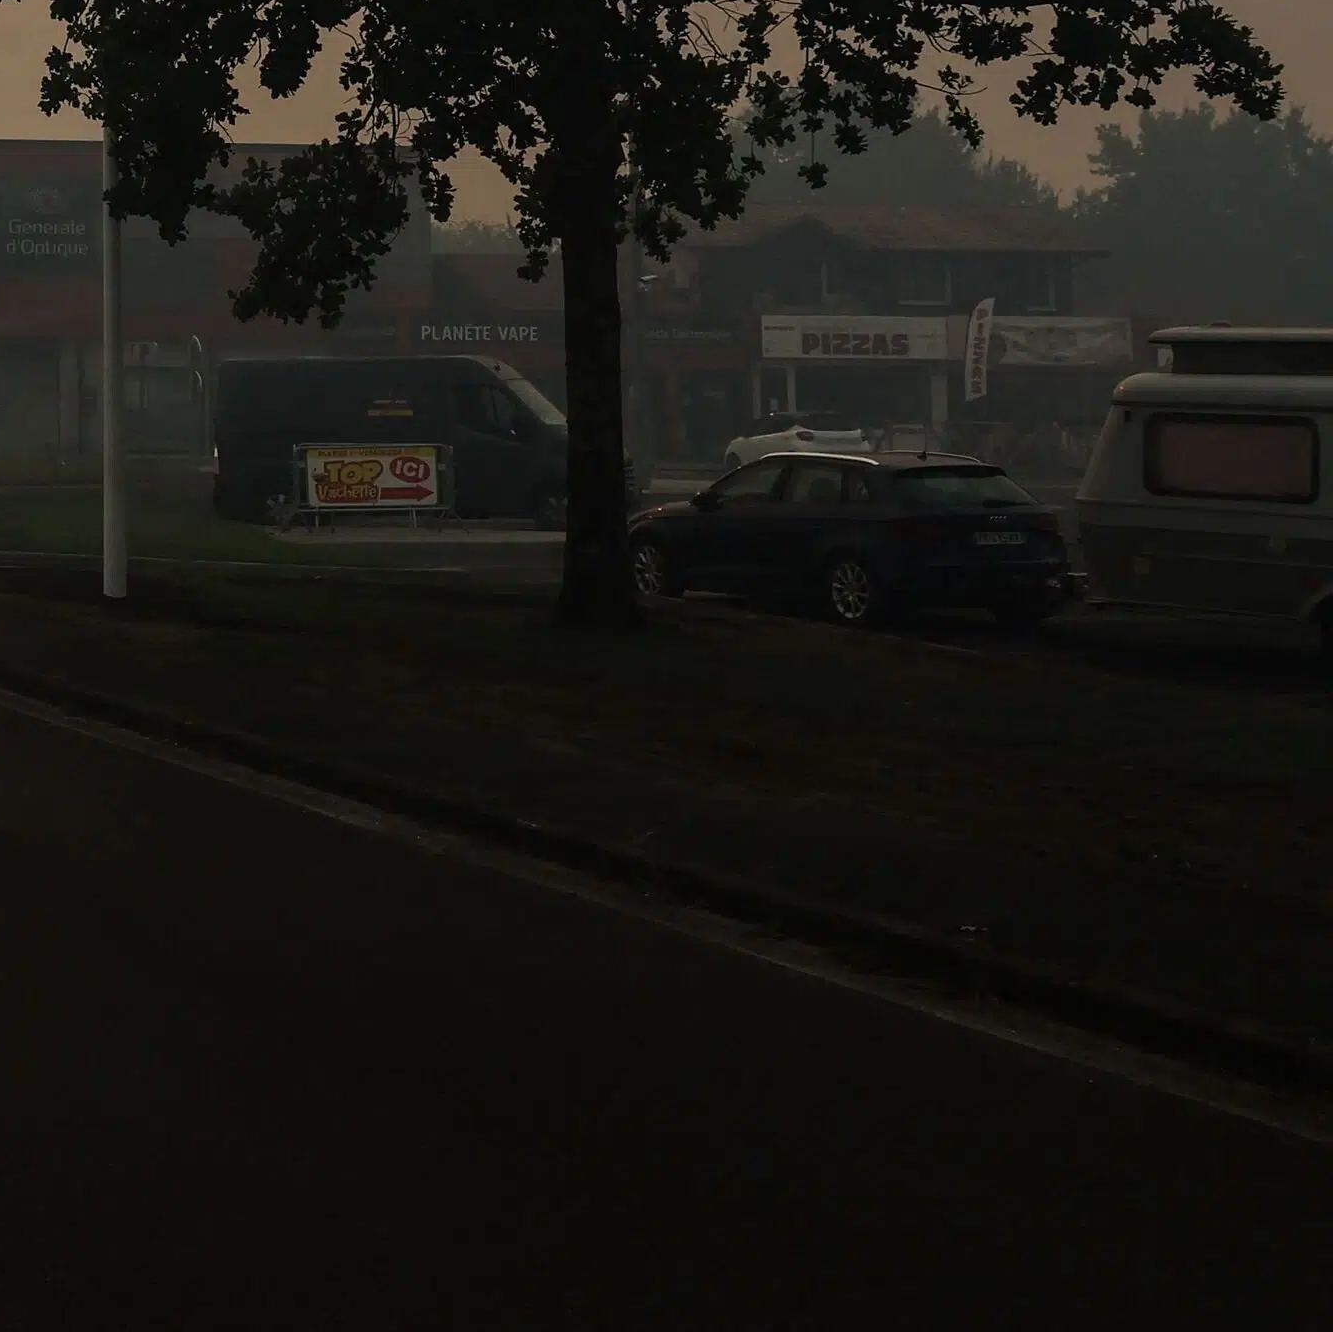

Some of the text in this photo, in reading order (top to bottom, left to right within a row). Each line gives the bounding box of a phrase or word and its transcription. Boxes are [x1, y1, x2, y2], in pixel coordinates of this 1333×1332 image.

[6, 238, 89, 261] d'Optique
[497, 325, 539, 341] VAPE
[801, 332, 910, 355] PIZZAS
[323, 459, 383, 485] TOP
[395, 459, 426, 479] ICI
